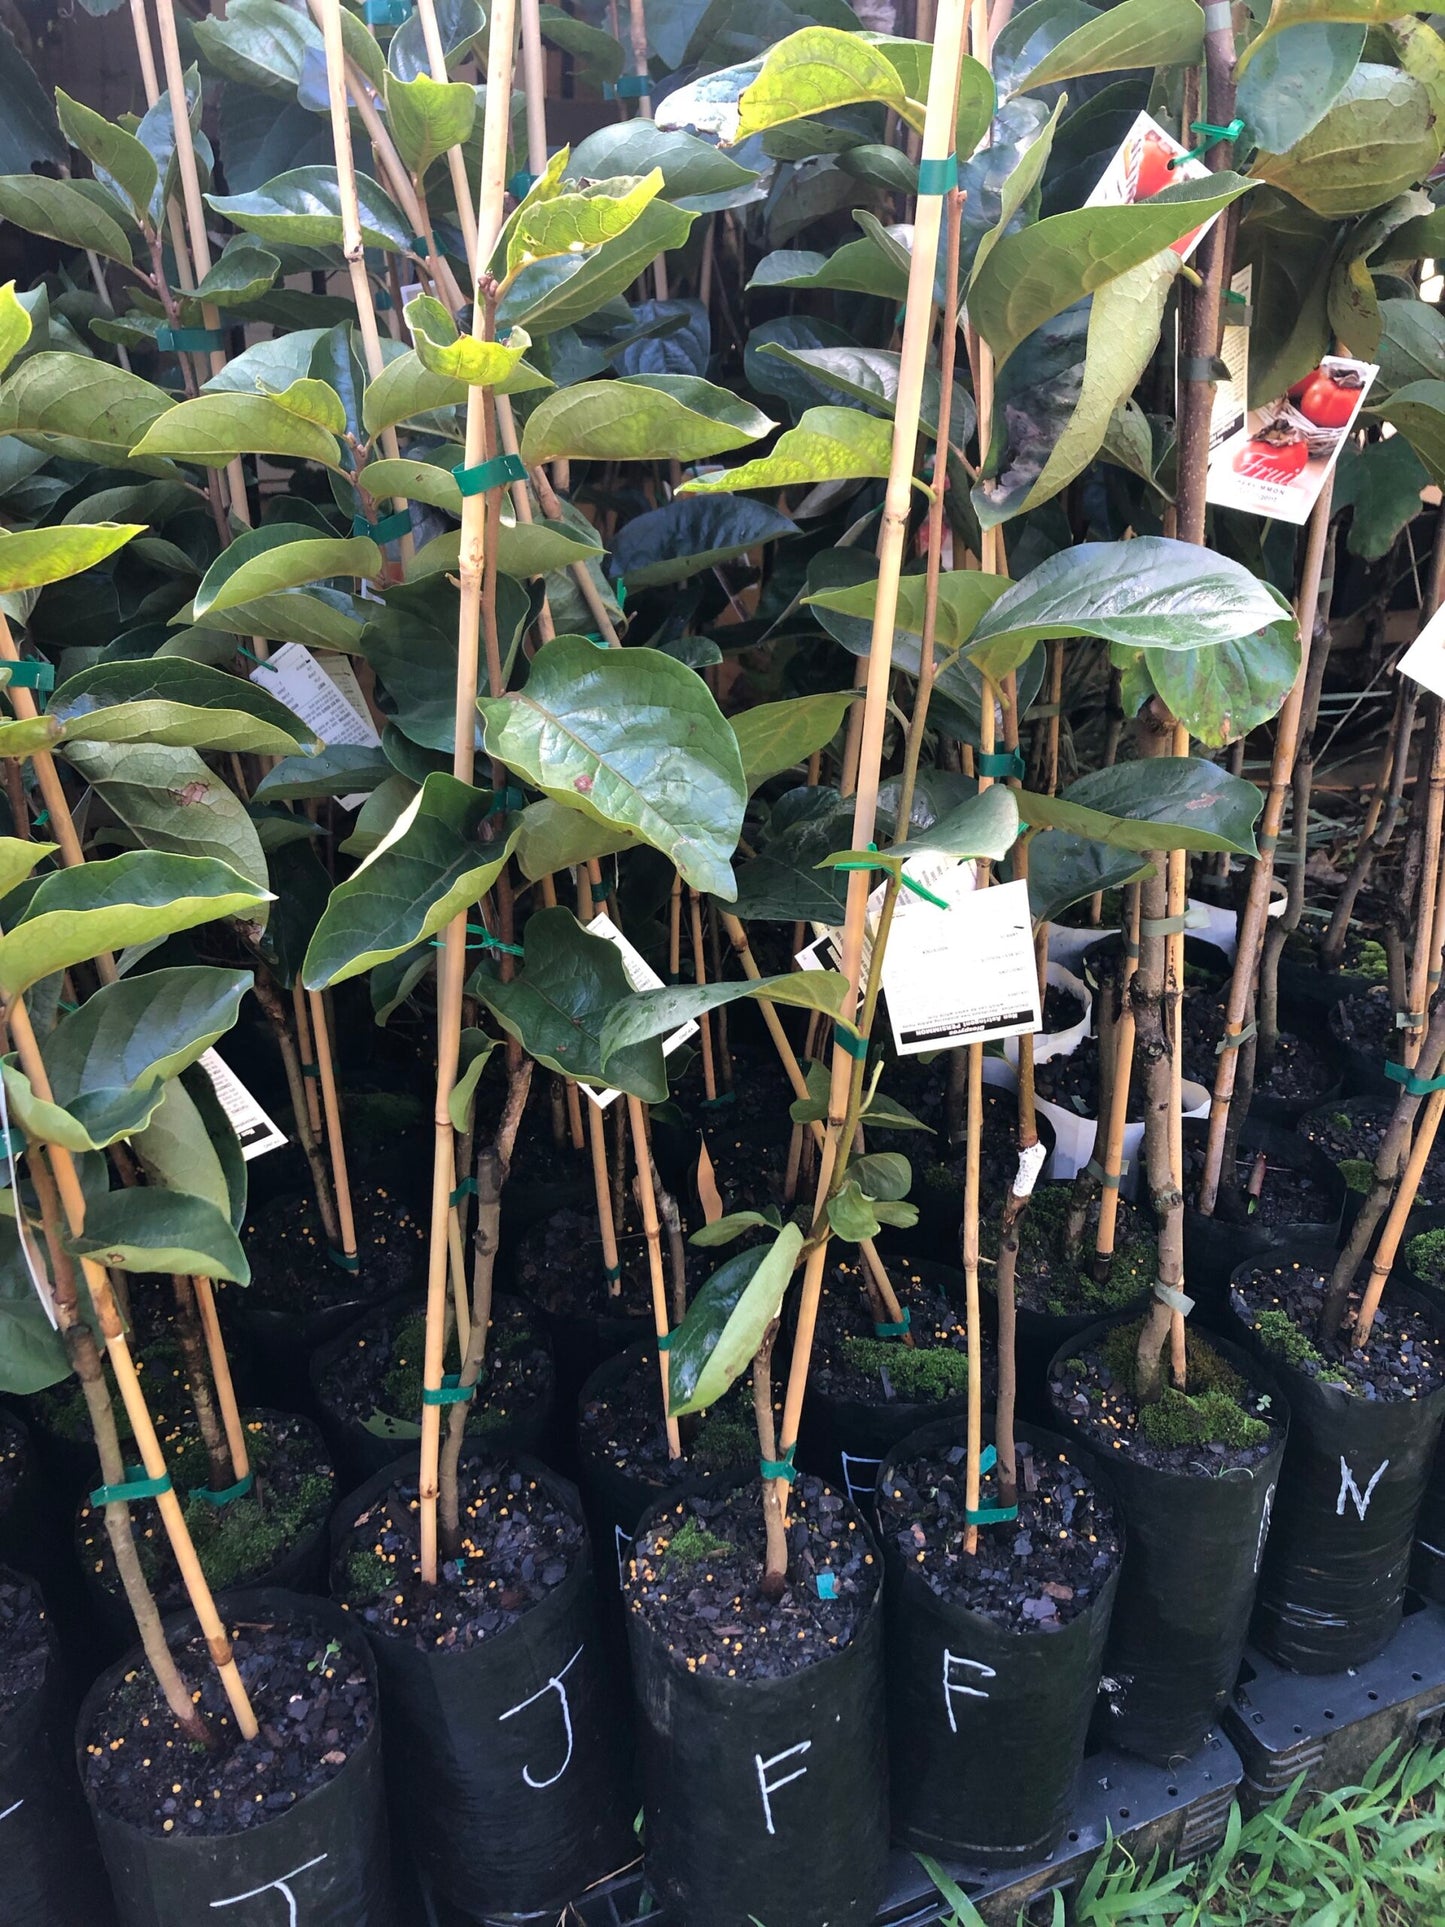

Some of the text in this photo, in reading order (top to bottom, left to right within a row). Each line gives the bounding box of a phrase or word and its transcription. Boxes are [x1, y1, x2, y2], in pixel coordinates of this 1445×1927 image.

[1336, 1455, 1390, 1521] N
[498, 1643, 585, 1788] J
[942, 1648, 997, 1733] F
[755, 1739, 813, 1834] F
